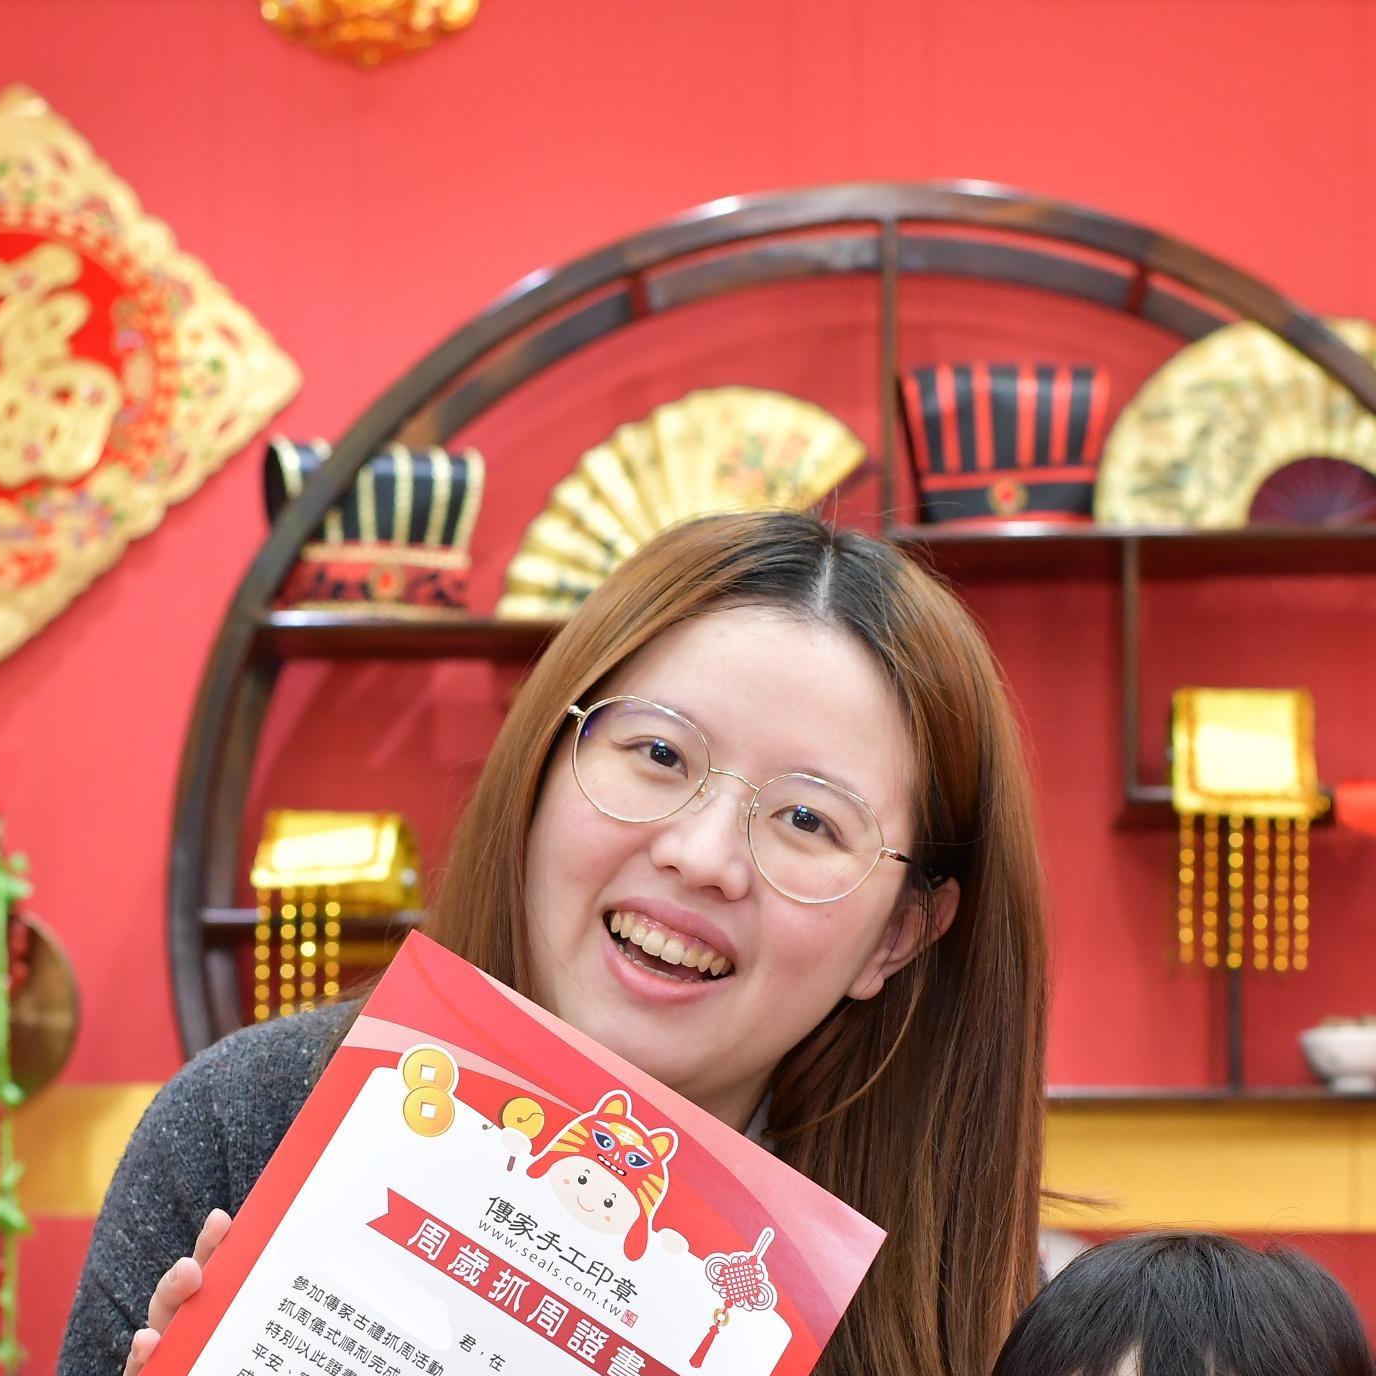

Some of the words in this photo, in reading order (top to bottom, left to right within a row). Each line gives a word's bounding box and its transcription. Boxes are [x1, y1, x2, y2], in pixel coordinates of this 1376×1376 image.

[478, 1219, 621, 1315] www.seals.com.tw
[485, 1196, 637, 1303] 傳家手工印章
